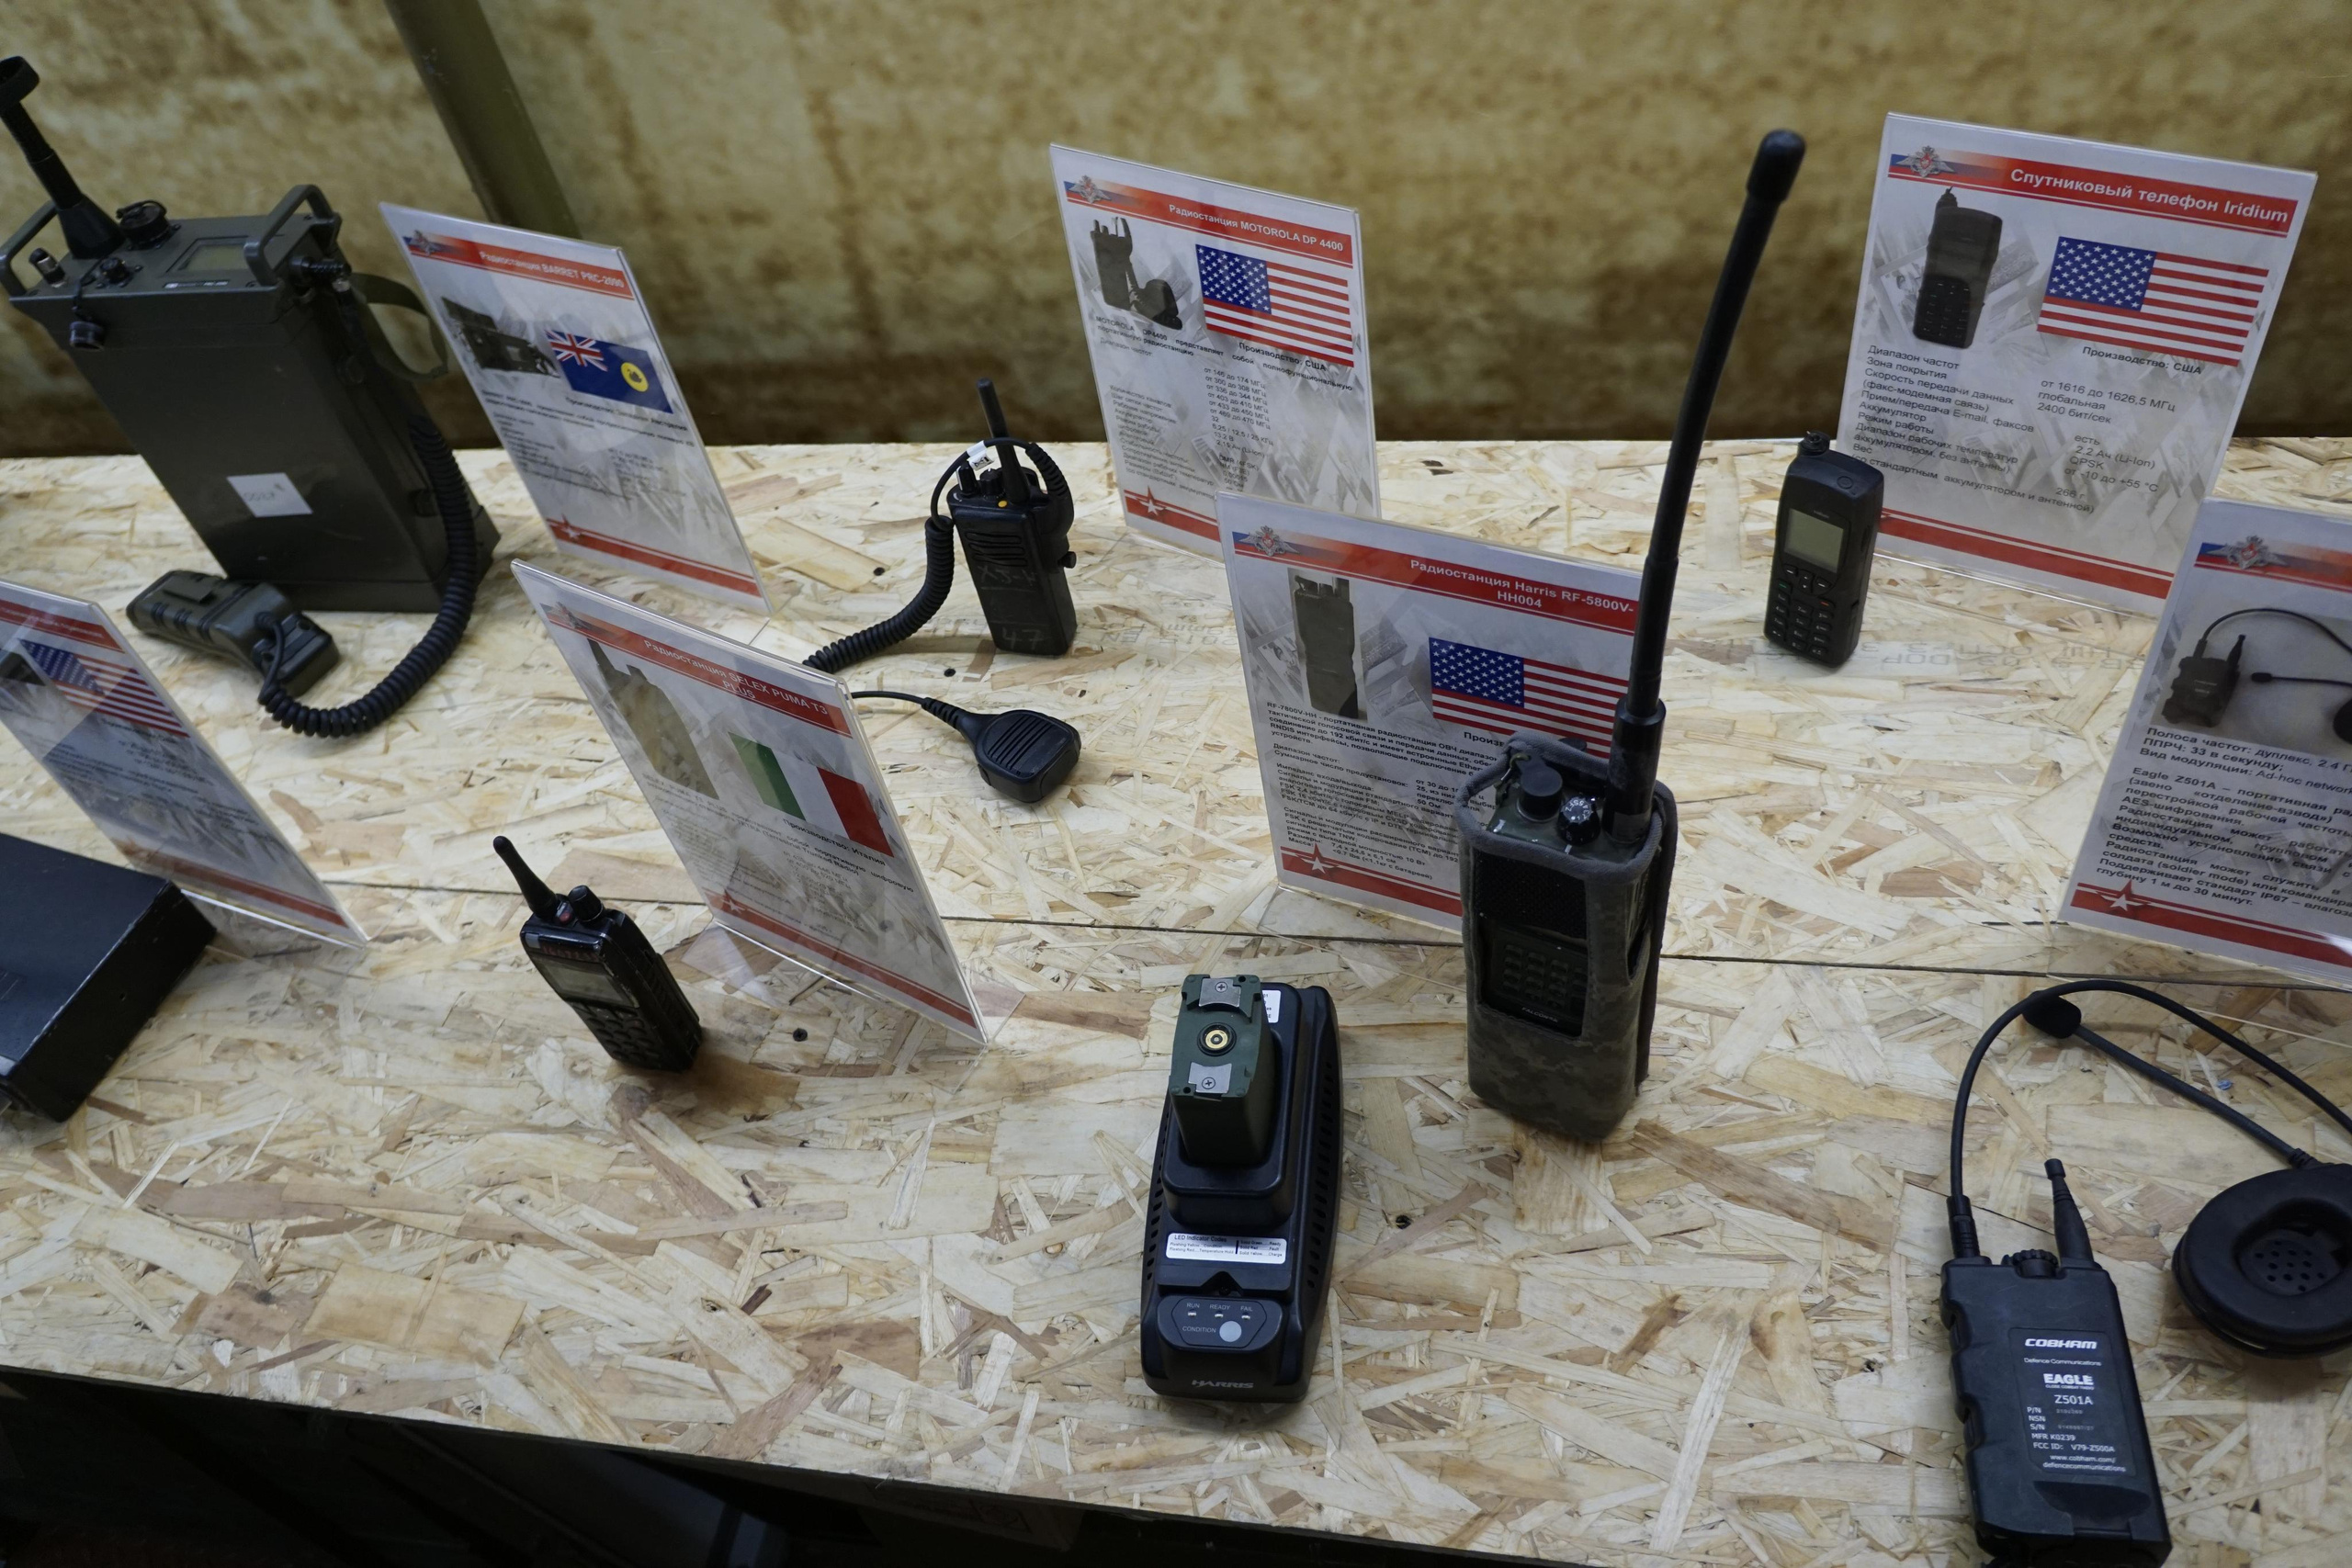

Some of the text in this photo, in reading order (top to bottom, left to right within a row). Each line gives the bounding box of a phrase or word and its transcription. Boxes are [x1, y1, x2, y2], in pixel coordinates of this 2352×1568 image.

[2010, 169, 2288, 223] Спутниковый телефон Iridium
[1169, 204, 1342, 252] Радиостанция MOTOROLA DP 4400
[1238, 342, 1327, 371] Производство: США
[1867, 344, 1959, 370] Диапазон частот
[1867, 356, 1946, 379] Зона покрытия
[2082, 345, 2202, 375] Производство: США
[1863, 378, 1989, 413] (факс-модемная связь)
[1865, 367, 2014, 405] Скорость передачи данных
[2038, 392, 2106, 411] глобальная
[2041, 381, 2176, 413] от 1616 до 1626,5 МГц
[1858, 411, 1933, 434] Режим работы
[1859, 400, 1926, 423] Аккумулятор
[1860, 389, 2034, 433] Прием/передача факсов
[2038, 402, 2111, 423] 2400 бит/сек
[1852, 443, 1872, 454] Вес
[1856, 422, 2018, 466] Диапазон рабочих температур
[2075, 435, 2100, 446] есть
[1939, 451, 2009, 475] без антенны)
[2064, 468, 2076, 477] от
[2100, 476, 2115, 484] до
[2120, 479, 2141, 489] +55
[2069, 456, 2104, 470] QPSK
[1869, 458, 1938, 479] стандартным
[1943, 474, 2025, 497] аккумулятором
[2038, 494, 2094, 513] антенной)
[1409, 559, 1634, 612] Радиостанция Harris RF-5800V-
[644, 638, 827, 715] Радиостанция SELEX PUMA T3
[722, 680, 755, 699] PLUS
[1268, 709, 1316, 726] тактической
[1317, 721, 1360, 736] голосовой
[1362, 731, 1385, 742] связи
[1395, 739, 1435, 753] передачи
[1323, 716, 1456, 752] портативная радиостанция ОВЧ
[2147, 727, 2251, 754] Полоса частот:
[1345, 734, 1370, 745] кбит/с
[1380, 743, 1404, 753] имеет
[1406, 749, 1456, 766] встроенные
[1351, 742, 1408, 761] позволяющие
[1410, 757, 1466, 775] подключение
[2140, 747, 2302, 785] Вид модуляции: Ad-hoc
[2143, 737, 2186, 752] ППРЧ:
[2190, 746, 2206, 756] 33
[2222, 754, 2283, 773] секунду;
[2129, 775, 2172, 792] (звено
[2133, 766, 2327, 811] Eagle Z501A портативная
[2126, 786, 2287, 824] перестройкой рабочей
[2120, 804, 2271, 841] Радиостанция может
[2109, 832, 2163, 849] средств.
[2112, 822, 2177, 842] Возможно
[2292, 861, 2332, 874] связи
[2254, 843, 2327, 863] групповом
[2099, 857, 2289, 904] Поддерживает стандарт IP67
[2103, 850, 2277, 891] солдата (soldier mode) или
[2106, 840, 2197, 865] Радиостанция
[2210, 863, 2251, 877] может
[2262, 874, 2319, 891] служить
[2097, 866, 2146, 885] глубину
[2151, 876, 2156, 885] 1
[2173, 883, 2190, 892] до
[2193, 886, 2209, 896] 30
[2211, 891, 2253, 905] минут.
[2024, 1338, 2098, 1349] COBHAM
[2050, 1359, 2102, 1367] Communications
[1192, 1380, 1254, 1389] HARRIS
[2043, 1373, 2094, 1386] EAGLE
[2053, 1394, 2094, 1405] Z501A
